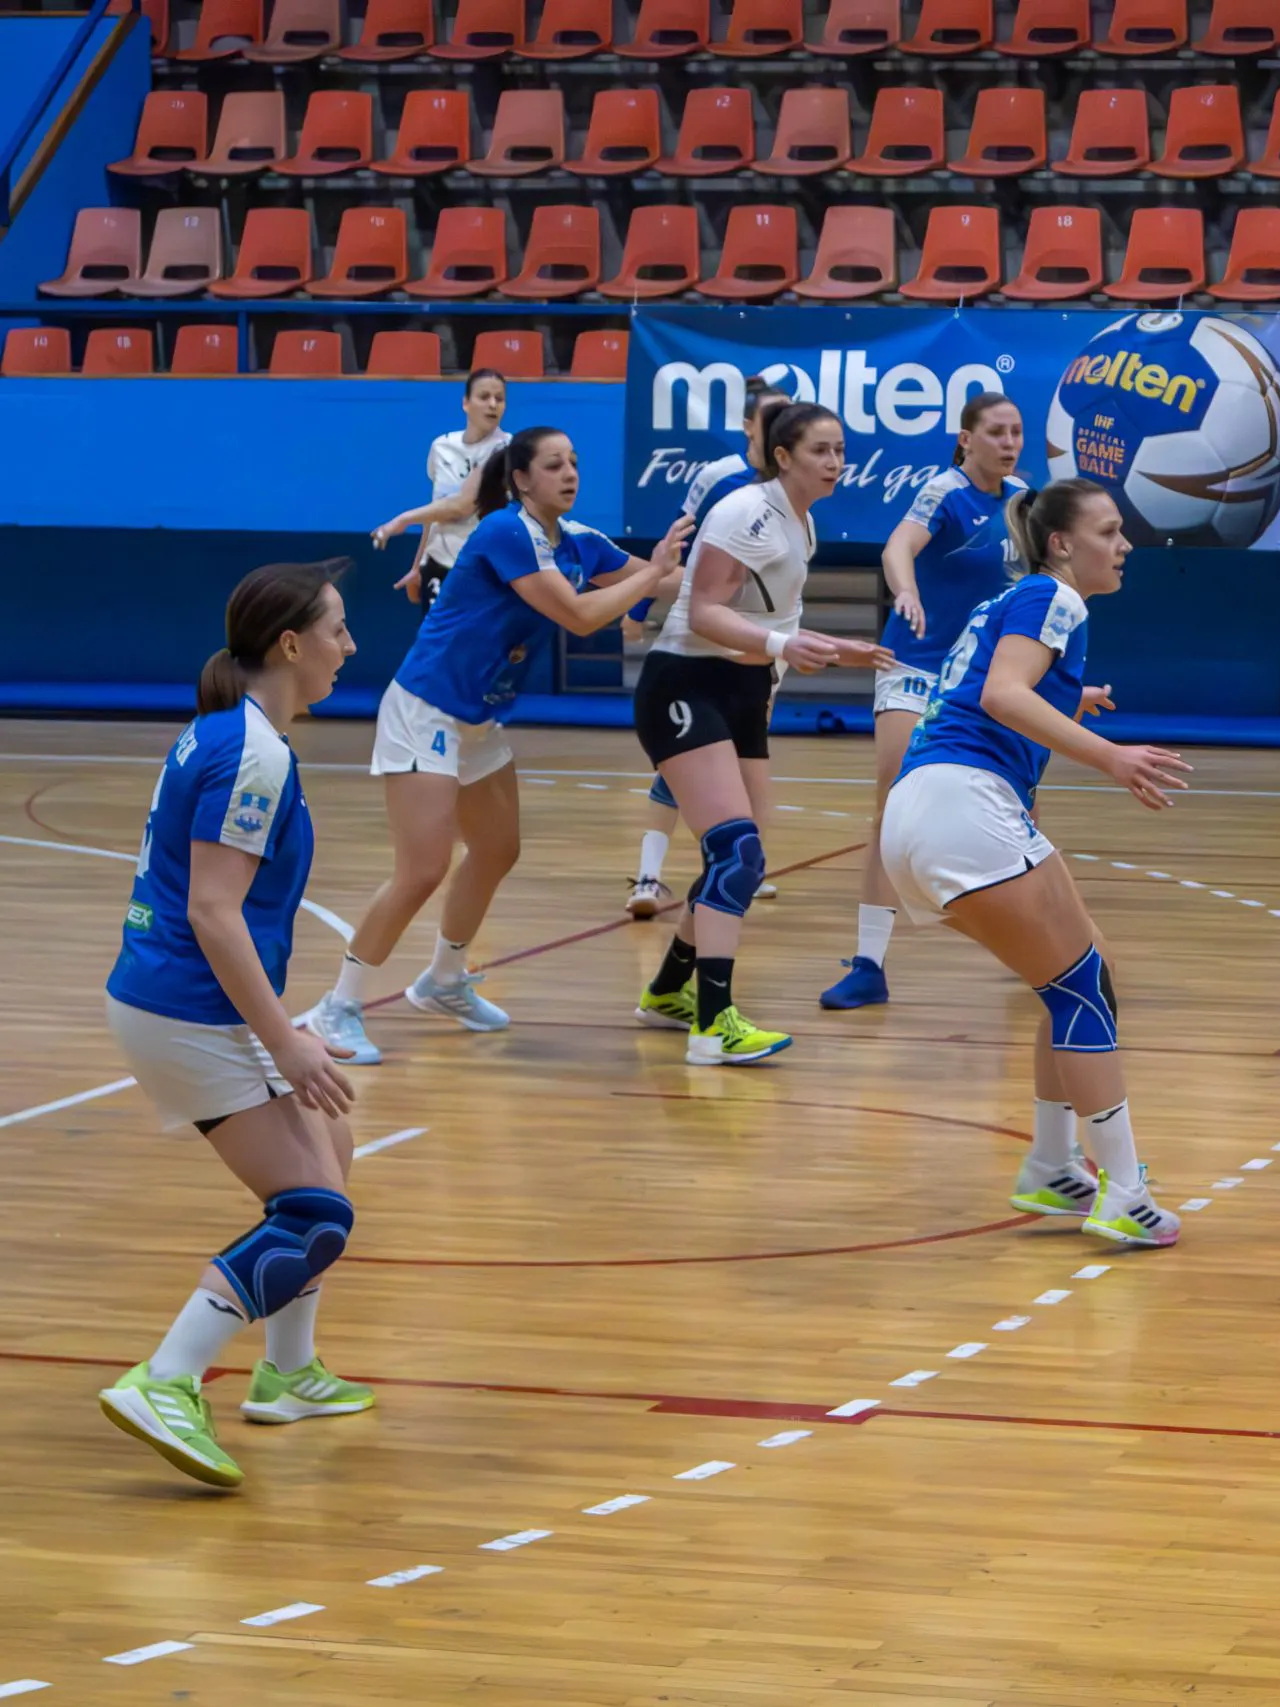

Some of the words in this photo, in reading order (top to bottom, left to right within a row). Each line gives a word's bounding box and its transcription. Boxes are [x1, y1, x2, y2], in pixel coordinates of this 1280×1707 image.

[1057, 213, 1073, 226] 18
[1063, 351, 1198, 413] molten
[1094, 413, 1115, 430] IHF
[1077, 437, 1125, 463] GAME
[1079, 455, 1118, 478] BALL
[903, 675, 927, 693] 10
[668, 700, 693, 739] 9
[430, 729, 446, 757] 4
